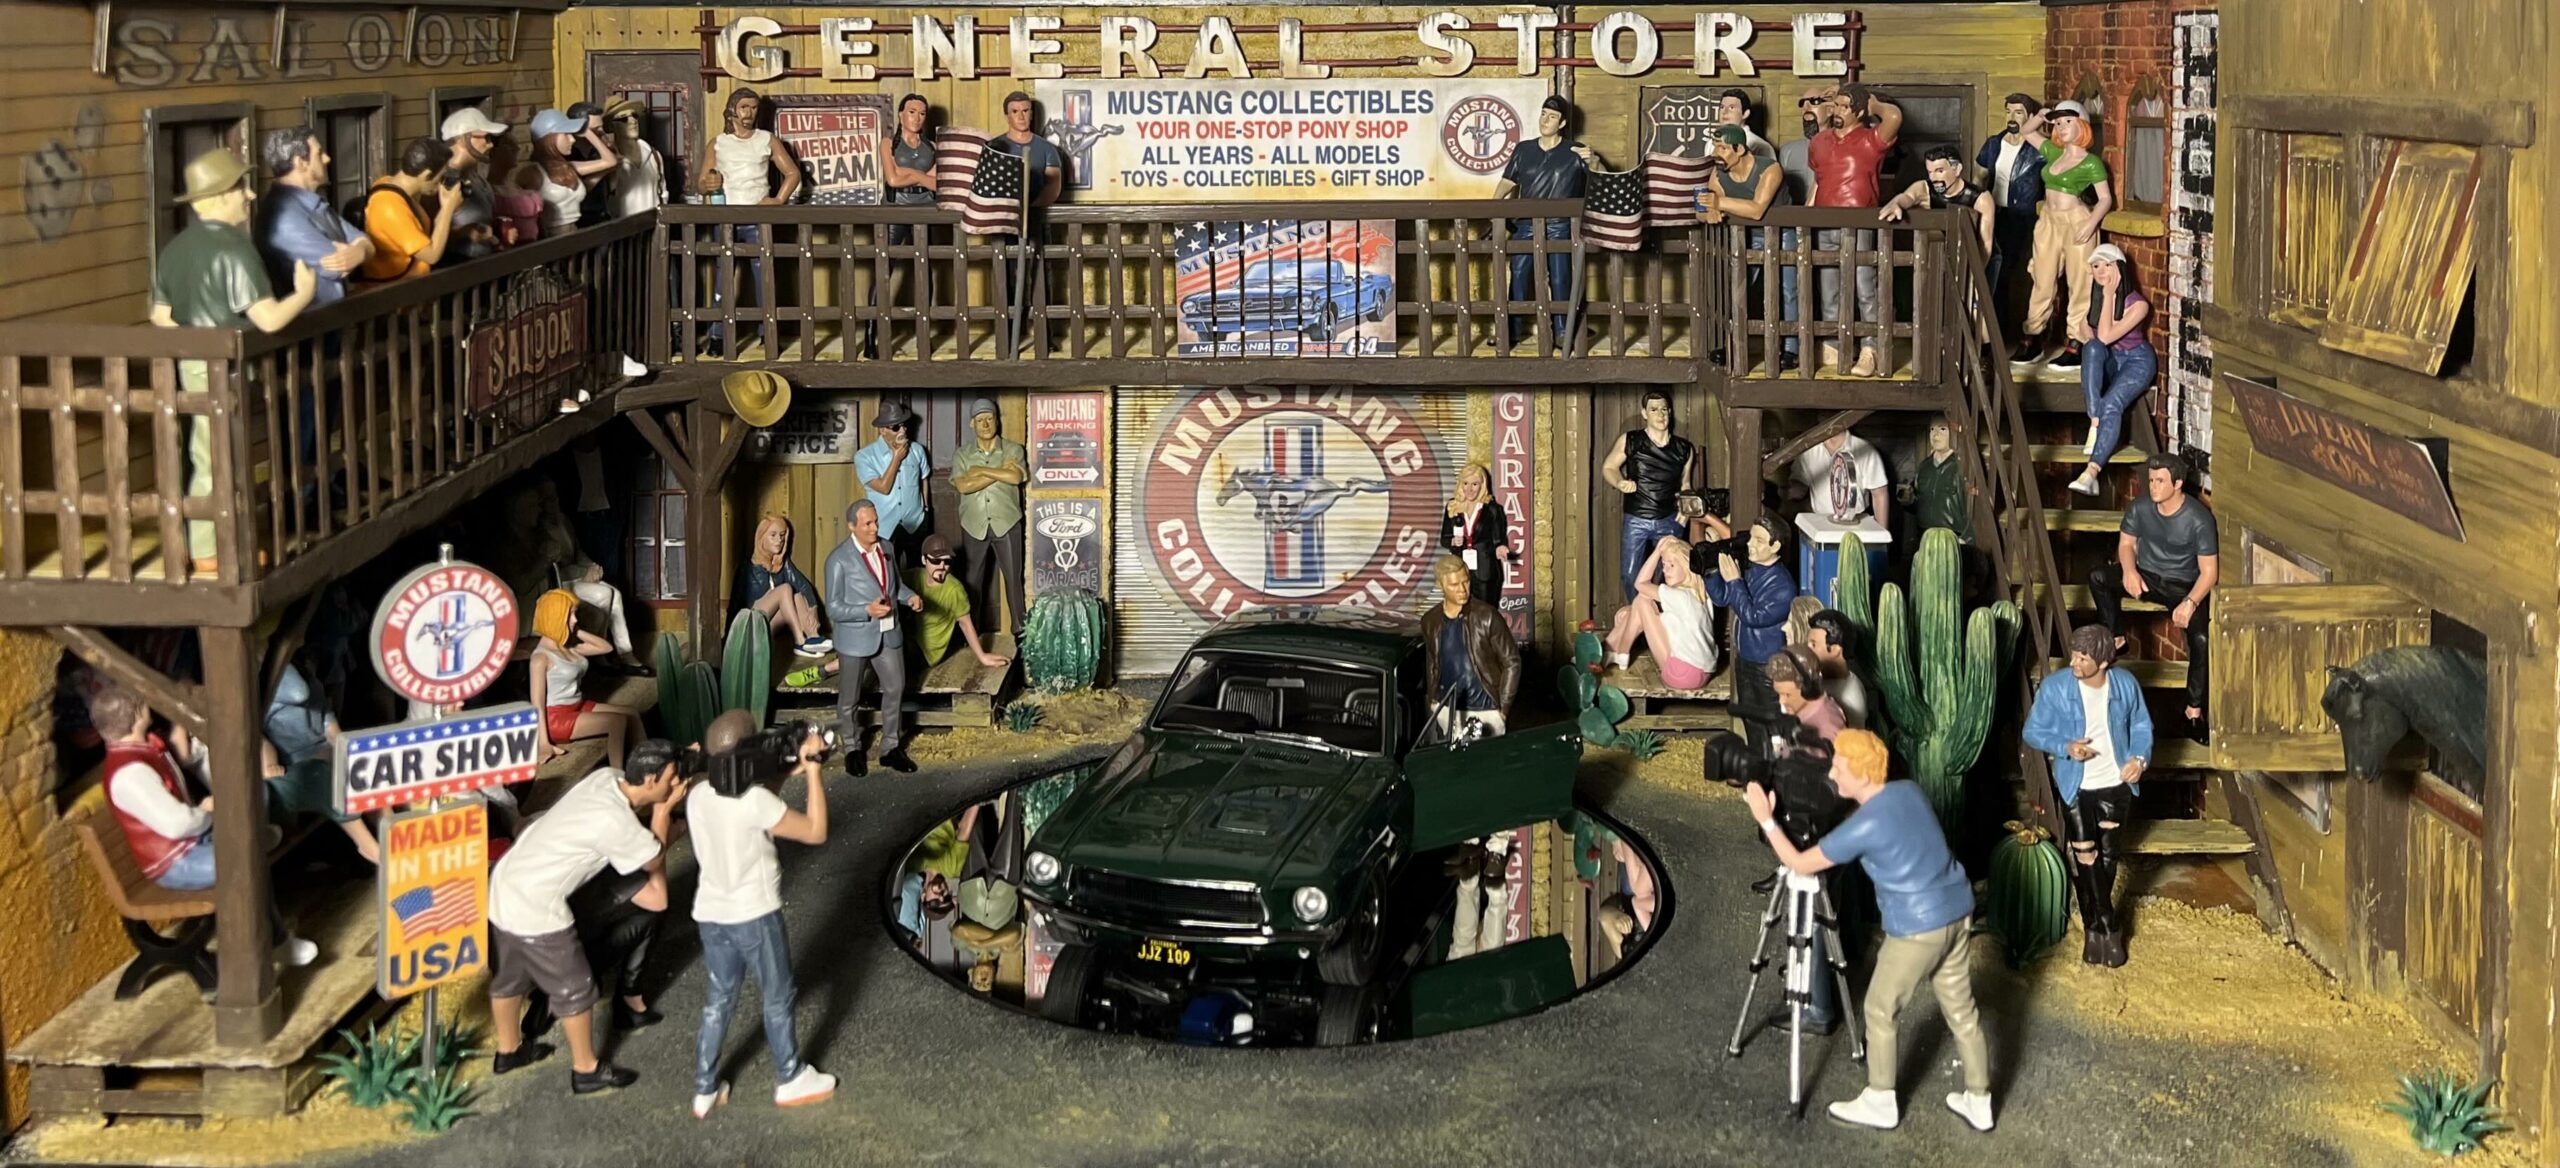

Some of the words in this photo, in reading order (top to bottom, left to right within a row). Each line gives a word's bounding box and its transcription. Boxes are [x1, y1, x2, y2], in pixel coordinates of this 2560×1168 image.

[116, 14, 502, 86] SALOON
[717, 15, 1331, 80] GENERAL
[1418, 11, 1847, 76] STORE
[1108, 90, 1232, 115] MUSTANG
[1241, 90, 1434, 114] COLLECTIBLES
[1448, 99, 1516, 130] MUSTANG
[1664, 105, 1720, 121] ROUT
[787, 114, 824, 132] LIVE
[835, 115, 869, 130] THE
[1137, 121, 1190, 139] YOUR
[1196, 121, 1292, 139] ONE-STOP
[1299, 120, 1350, 138] PONY
[1355, 120, 1408, 138] SHOP
[795, 135, 871, 158] MERICAN
[1142, 146, 1180, 165] ALL
[1186, 146, 1254, 165] YEARS
[1271, 146, 1309, 164] ALL
[1316, 145, 1400, 164] MODELS
[1446, 137, 1517, 173] COLLECTIBLES
[800, 154, 876, 187] REAM
[1121, 170, 1168, 187] TOYS
[1184, 170, 1316, 187] COLLECTIBLES
[1331, 169, 1371, 187] GIFT
[1375, 169, 1424, 187] SHOP
[1179, 222, 1326, 276] MUSTANG
[487, 306, 574, 396] SALOON
[1346, 337, 1380, 355] 64
[1036, 399, 1096, 421] MUSTANG
[1036, 422, 1096, 430] PARKING
[2277, 399, 2378, 467] LIVERY
[755, 433, 840, 455] OFFICE
[1044, 470, 1088, 479] ONLY
[1498, 392, 1526, 589] GARAGE
[1036, 502, 1065, 519] THIS
[1070, 502, 1083, 515] IS
[1087, 507, 1096, 519] A
[1048, 518, 1084, 534] Ford
[1034, 567, 1099, 592] GARAGE
[1157, 518, 1429, 620] COLLLES
[388, 570, 513, 631] MUSTANG
[1499, 596, 1529, 611] Open
[385, 638, 512, 700] COLLECTIBLES
[350, 748, 424, 793] CAR
[435, 728, 536, 777] SHOW
[391, 808, 483, 854] MADE
[389, 854, 421, 884] IN
[427, 839, 482, 875] THE
[390, 935, 479, 987] USA
[1137, 943, 1162, 961] JJZ
[1167, 948, 1191, 966] 109
